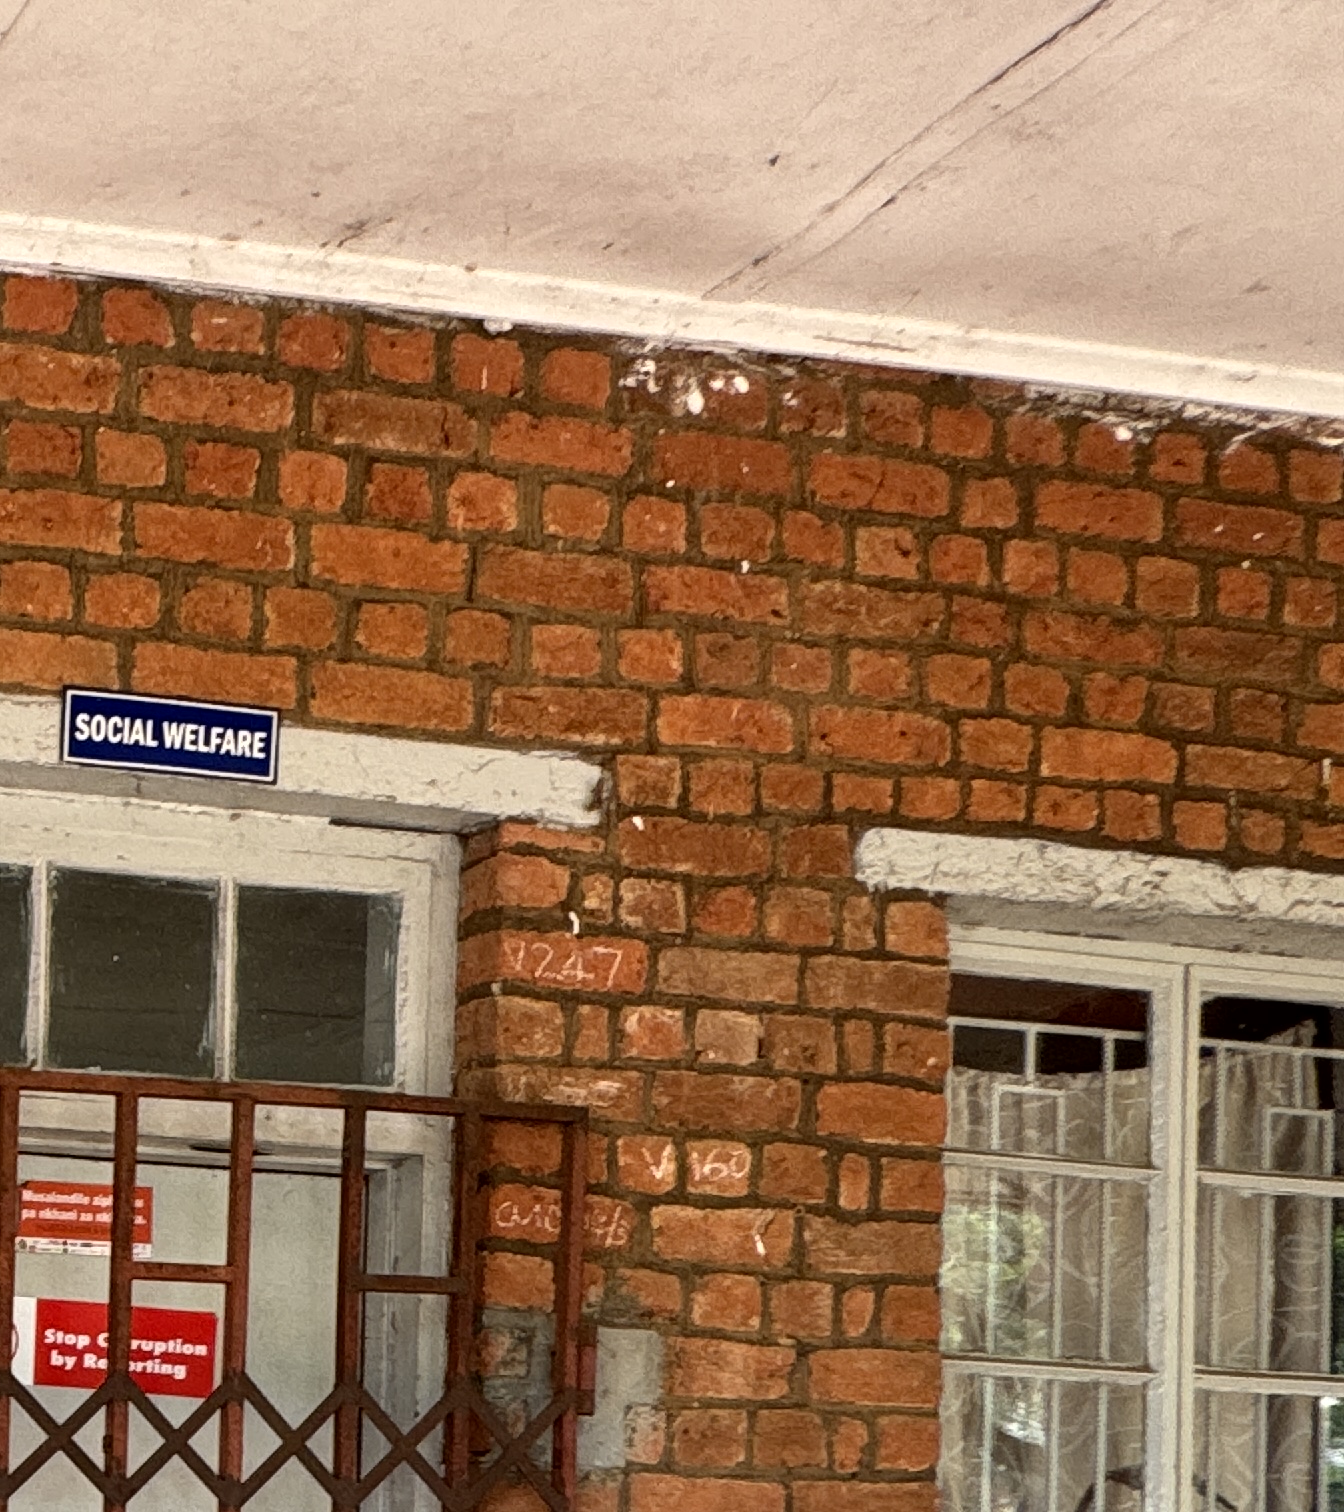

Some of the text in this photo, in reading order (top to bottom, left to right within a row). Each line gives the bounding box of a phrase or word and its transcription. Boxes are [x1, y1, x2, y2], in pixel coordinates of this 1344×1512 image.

[74, 712, 268, 759] SOCIAL WELFARE
[43, 1328, 209, 1356] Stop Cruption
[50, 1349, 187, 1380] by Rerting
